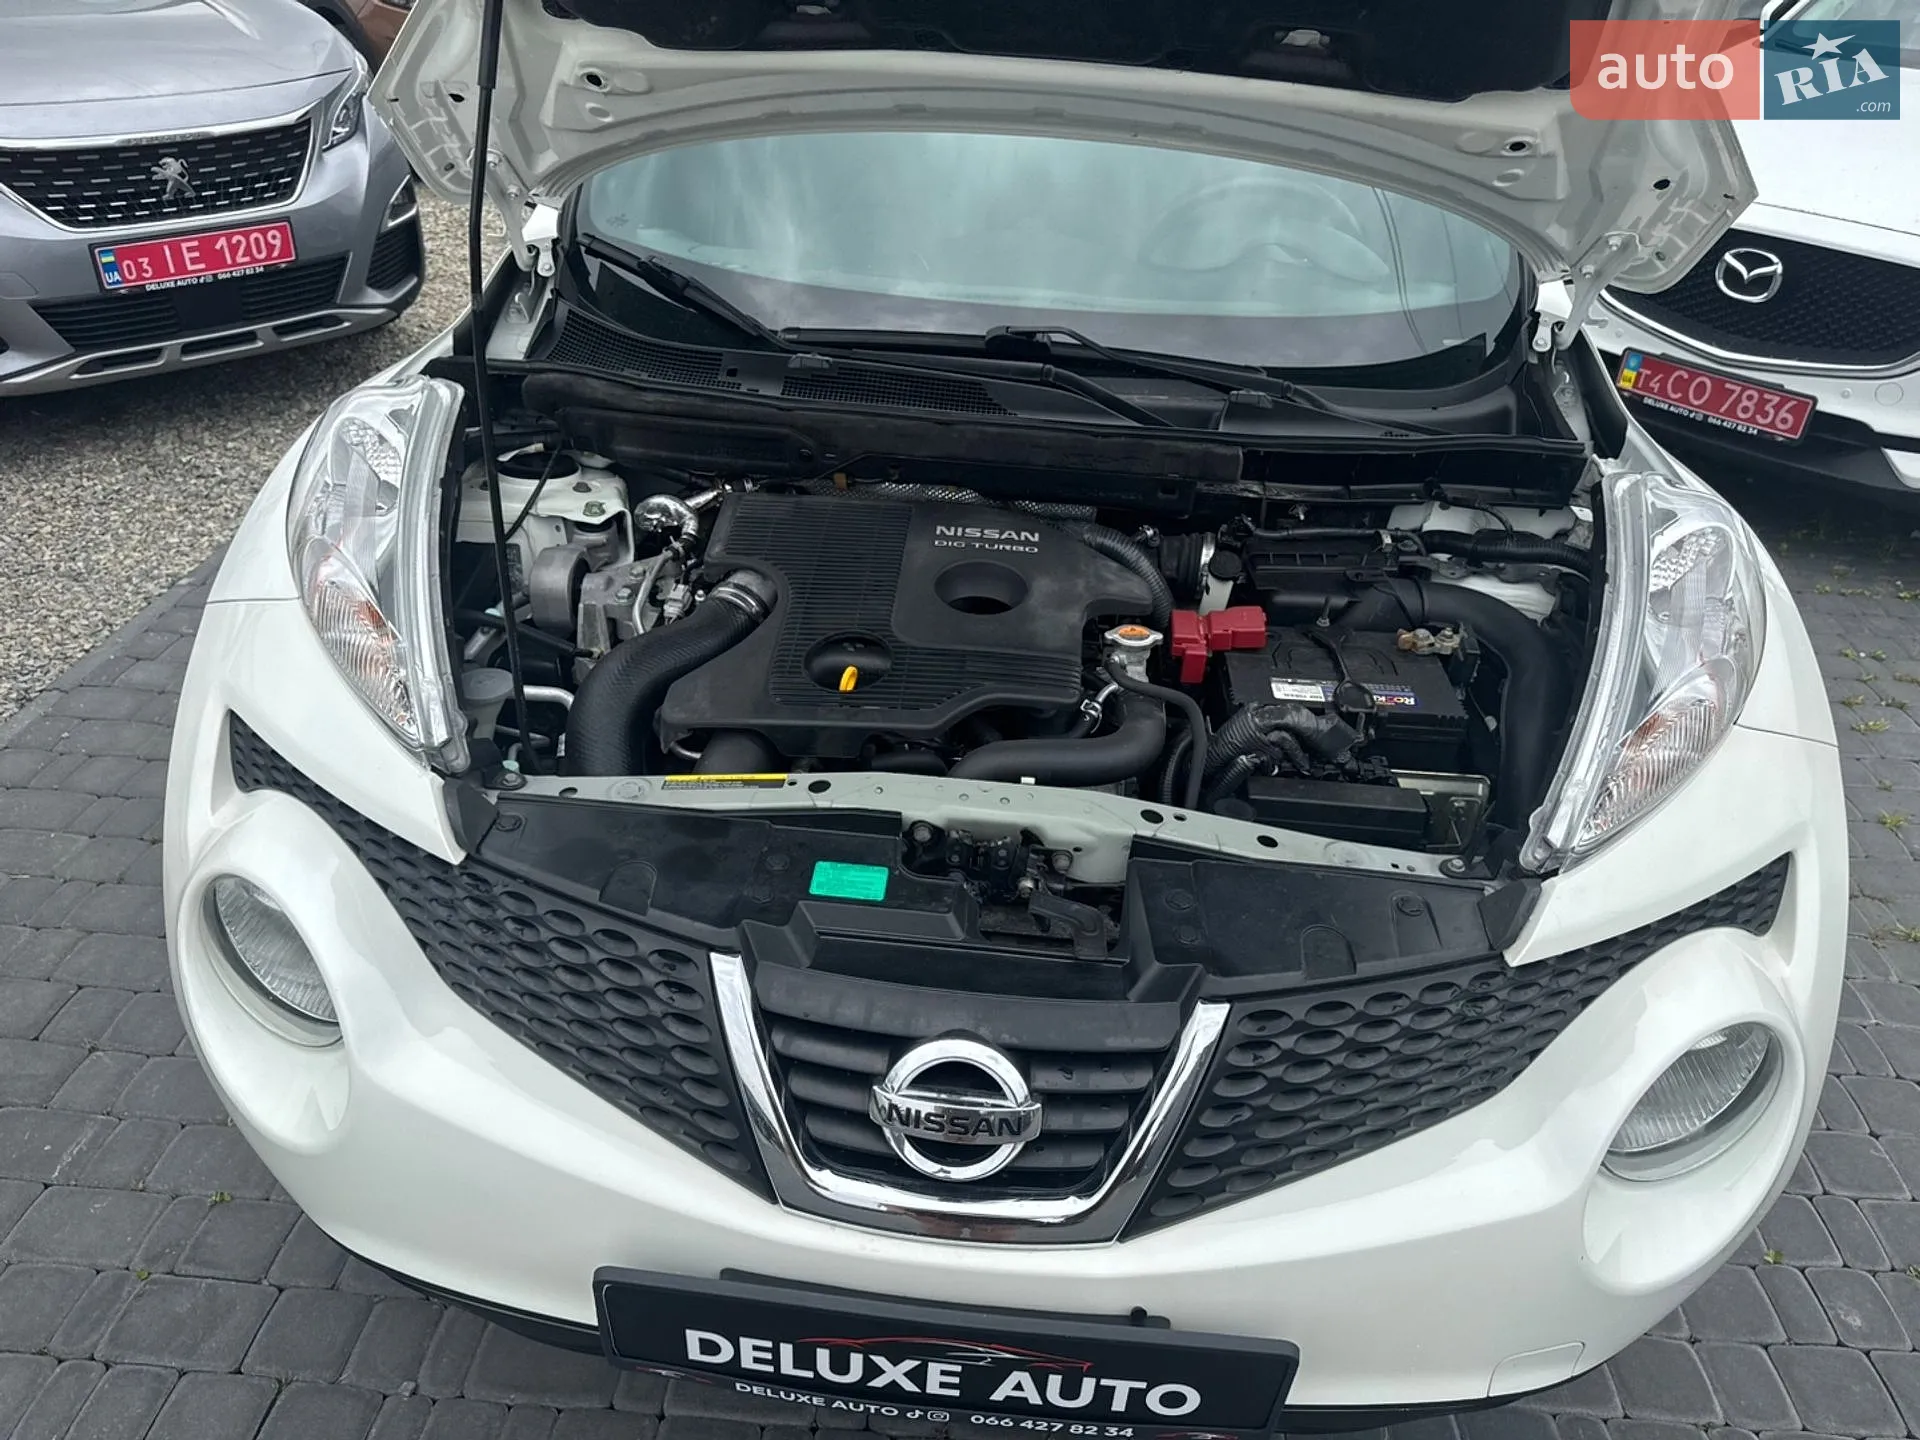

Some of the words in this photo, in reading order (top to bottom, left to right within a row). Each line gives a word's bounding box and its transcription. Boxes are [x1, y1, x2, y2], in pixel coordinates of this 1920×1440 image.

[122, 257, 153, 281] 03
[163, 241, 206, 274] IE
[214, 229, 283, 265] 1209
[105, 271, 122, 283] UA
[145, 280, 176, 292] DELUXE
[177, 276, 199, 287] AUTO
[217, 271, 232, 281] 066
[232, 269, 245, 279] 427
[1637, 367, 1664, 393] T4
[1667, 370, 1712, 406] CO
[1718, 383, 1799, 430] 7836
[1643, 396, 1670, 411] DELUXE
[1670, 404, 1690, 417] AUTO
[1707, 416, 1722, 427] 066
[1721, 419, 1737, 430] 427
[934, 539, 966, 549] DIG
[971, 541, 1039, 553] TURBO
[935, 525, 1040, 542] NISSAN
[886, 1103, 1022, 1137] NISSAN
[685, 1329, 962, 1397] DELUXE
[990, 1376, 1201, 1417] AUTO
[735, 1381, 826, 1407] DELUXE
[831, 1399, 900, 1417] AUTO
[971, 1413, 1013, 1428] 066
[1018, 1417, 1065, 1433] 427
[1071, 1422, 1099, 1437] 82
[1104, 1425, 1135, 1438] 34
